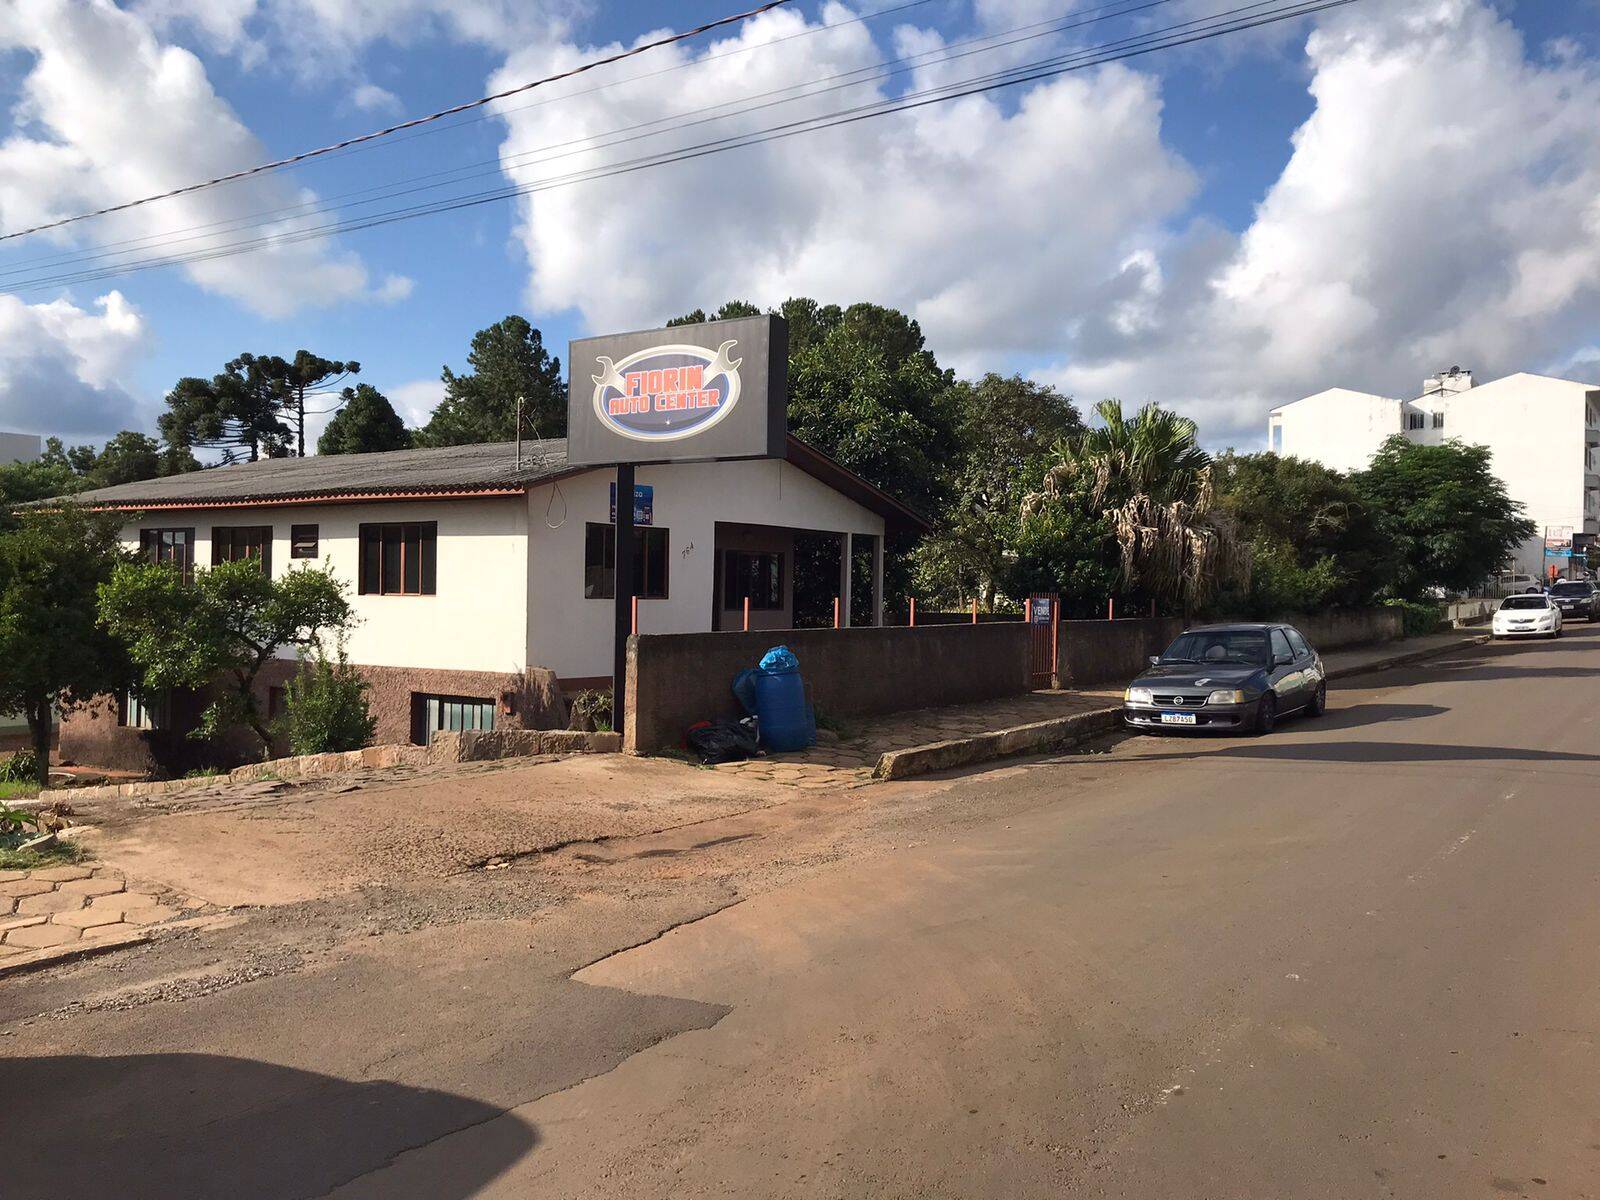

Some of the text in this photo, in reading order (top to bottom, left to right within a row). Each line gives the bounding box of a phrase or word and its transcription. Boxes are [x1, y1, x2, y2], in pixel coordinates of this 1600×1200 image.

[625, 365, 703, 397] FIORIN
[609, 389, 720, 415] AUTO CENTER
